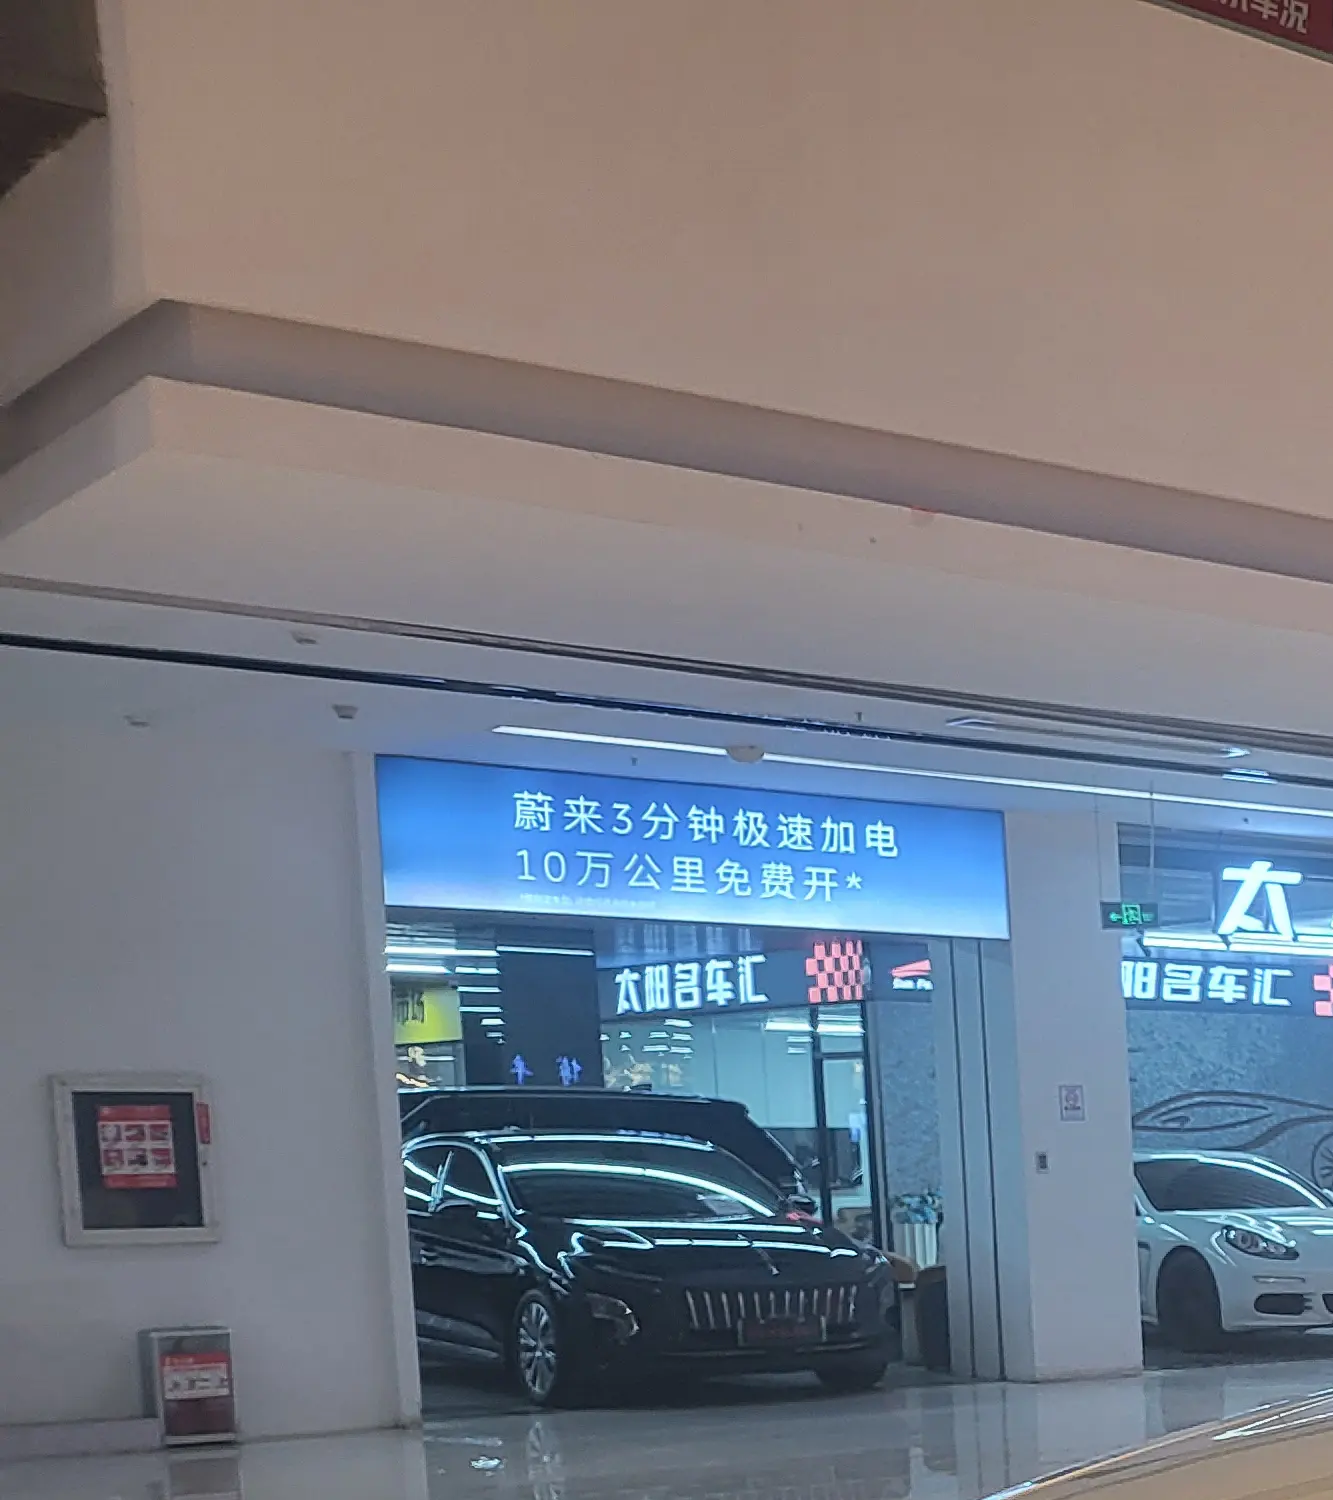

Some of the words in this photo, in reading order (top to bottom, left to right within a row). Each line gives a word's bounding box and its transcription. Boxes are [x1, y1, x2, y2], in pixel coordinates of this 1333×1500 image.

[512, 789, 899, 859] 蔚来3分钟极速加电
[614, 953, 770, 1015] 太阳名车汇
